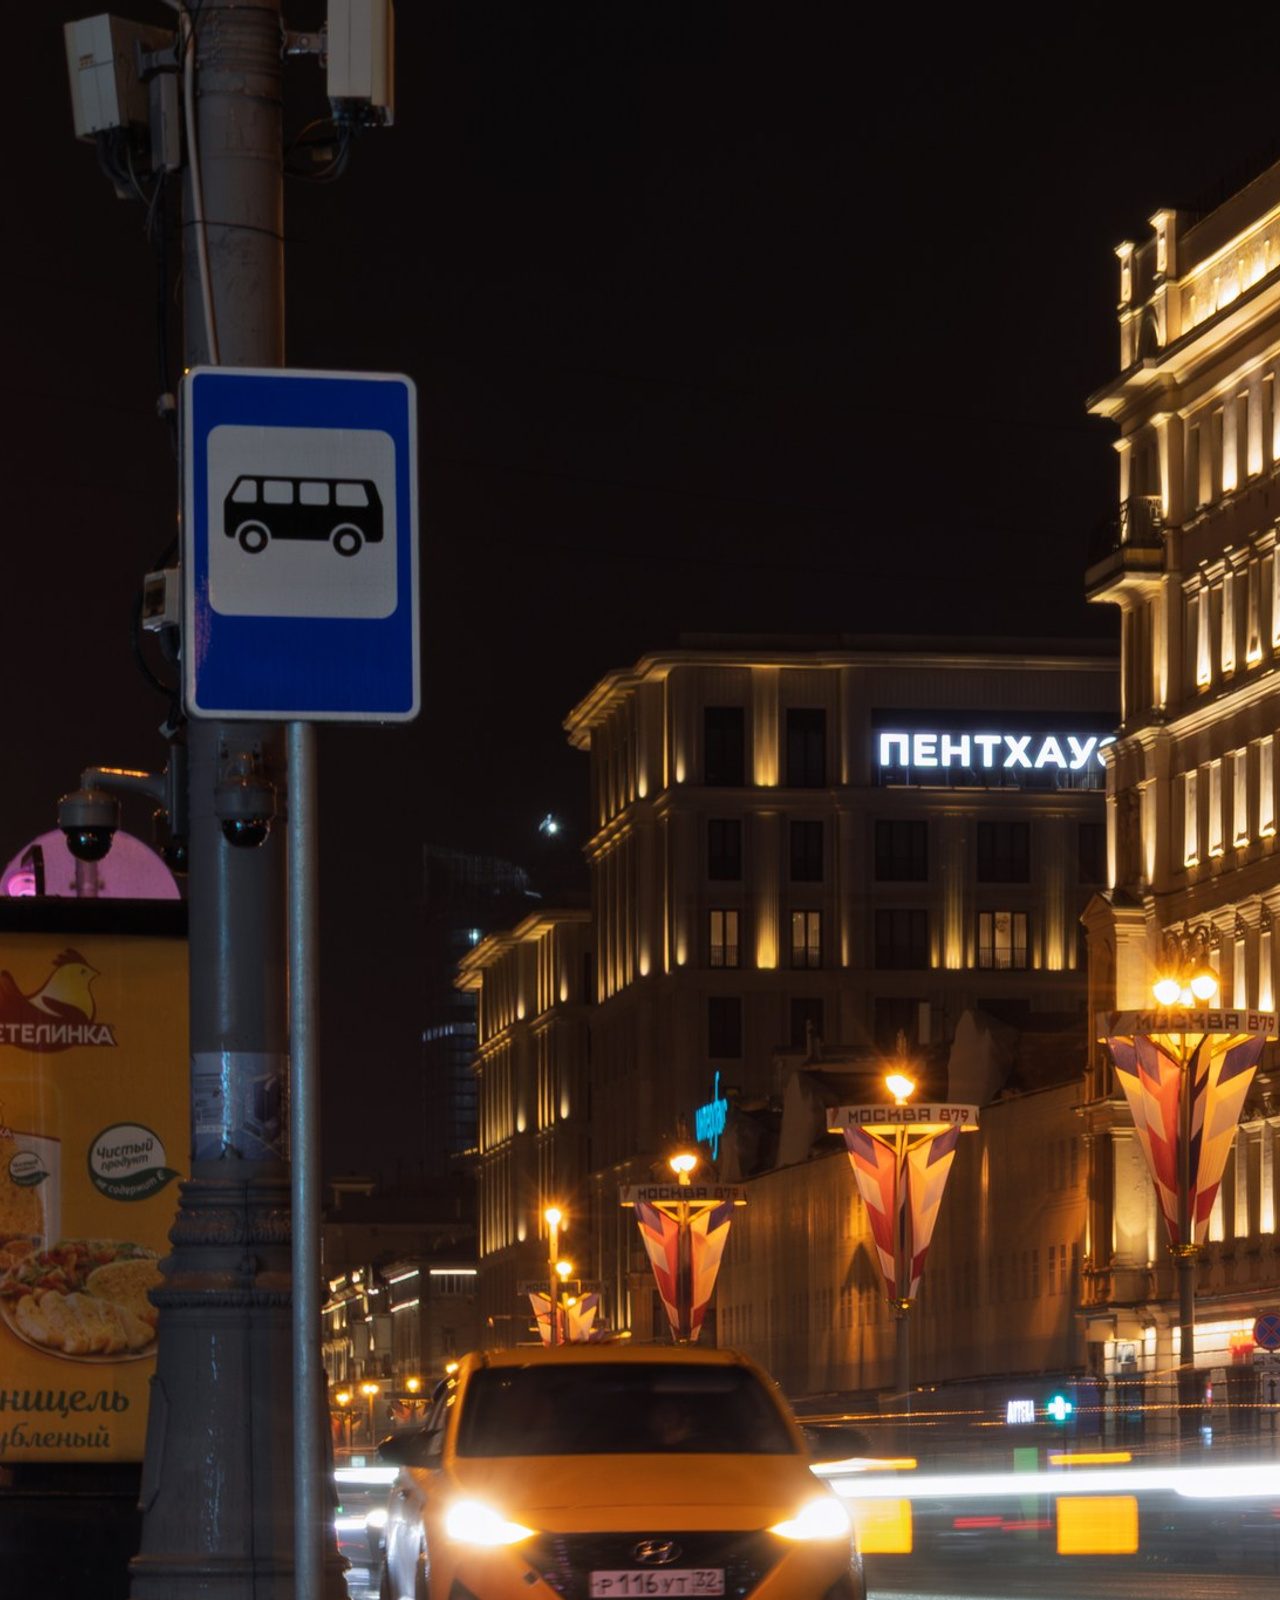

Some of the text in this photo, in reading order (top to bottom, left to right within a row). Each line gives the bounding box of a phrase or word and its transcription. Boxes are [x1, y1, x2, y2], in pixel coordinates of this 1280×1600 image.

[1247, 1014, 1275, 1033] 879
[848, 1107, 969, 1123] МОСКВА 879
[96, 1138, 154, 1160] Чистый
[101, 1154, 149, 1173] продукт
[637, 1187, 708, 1200] МОСКВА
[600, 1573, 689, 1595] Р116УТ
